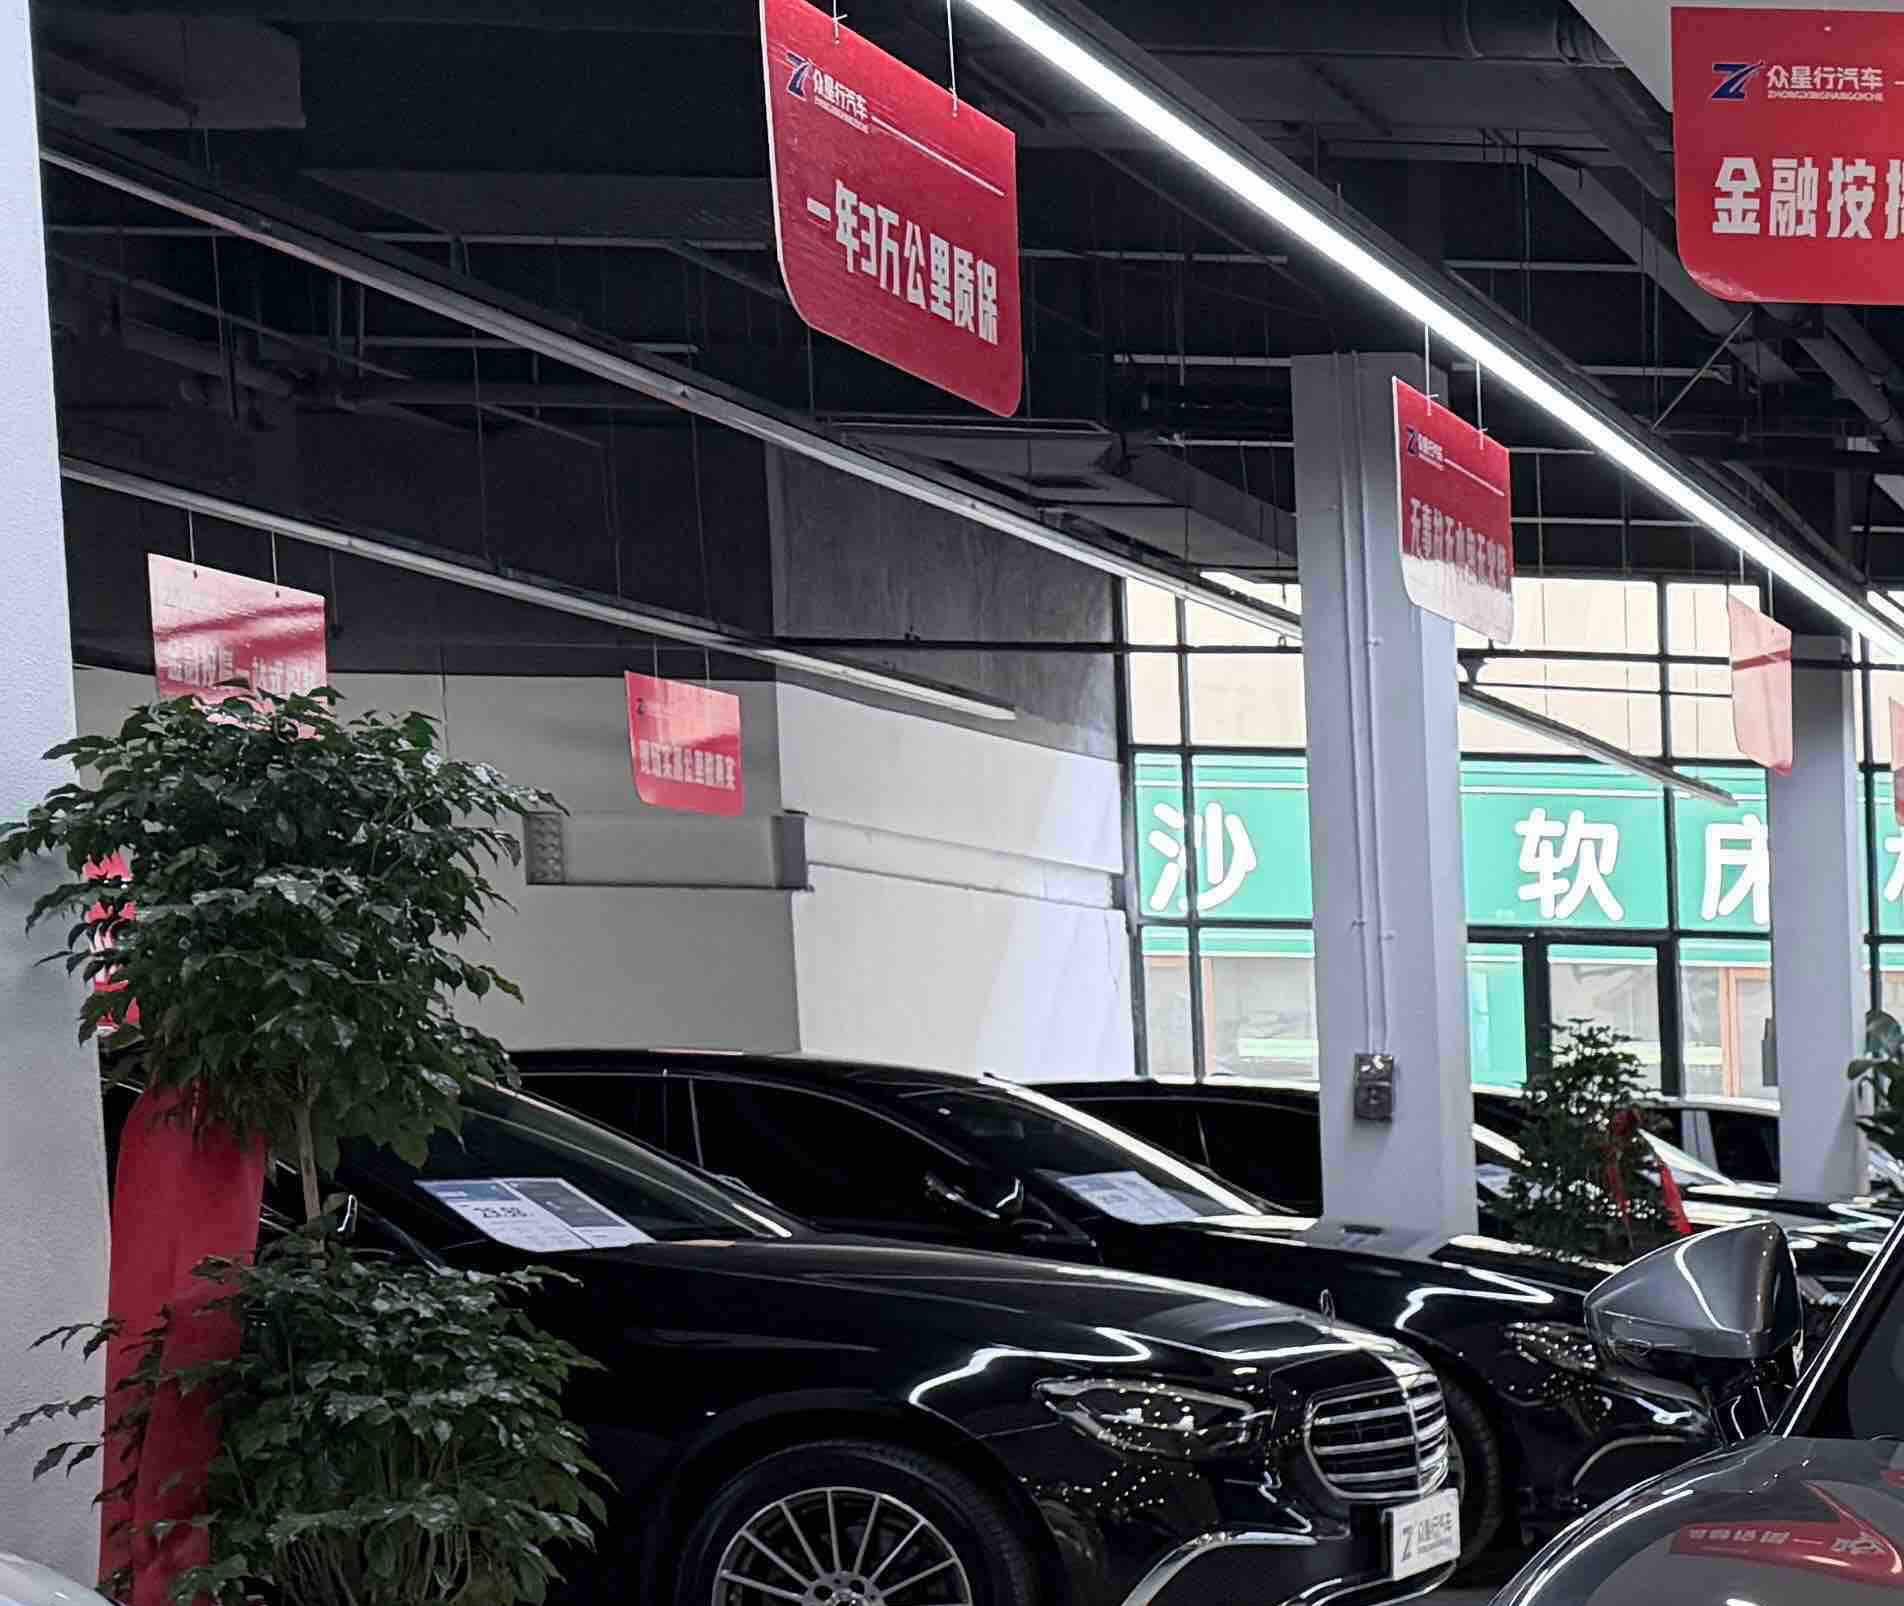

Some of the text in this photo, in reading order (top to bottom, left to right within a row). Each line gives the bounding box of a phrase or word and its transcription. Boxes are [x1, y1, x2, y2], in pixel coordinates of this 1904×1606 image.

[1767, 65, 1884, 91] 众星行汽车
[806, 178, 998, 346] 一年3万公里质保
